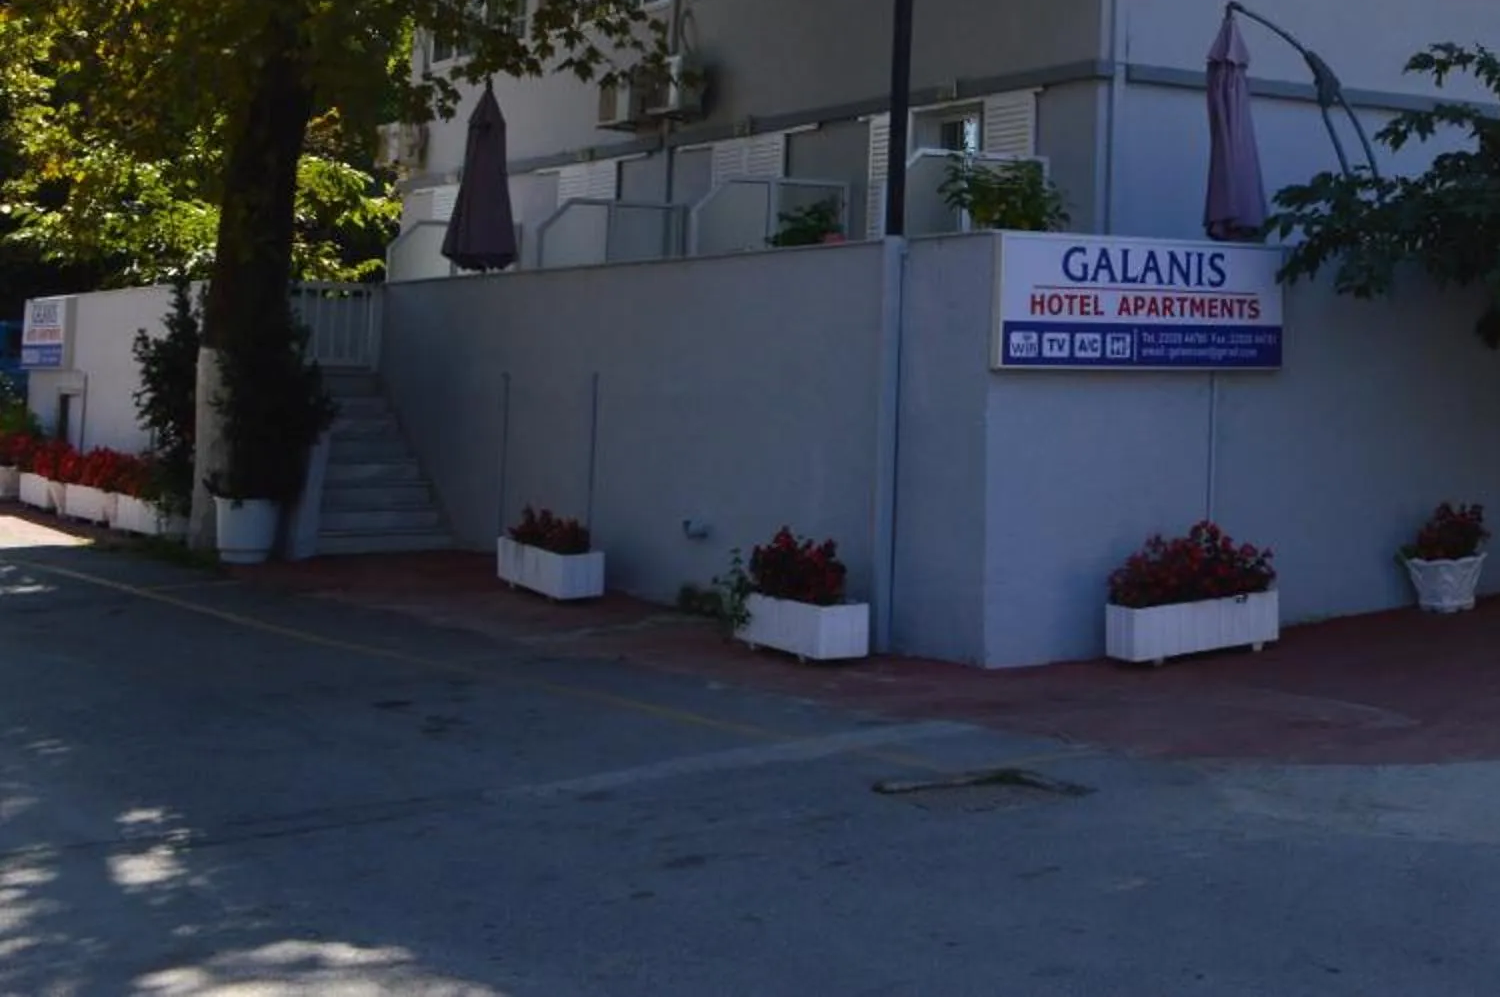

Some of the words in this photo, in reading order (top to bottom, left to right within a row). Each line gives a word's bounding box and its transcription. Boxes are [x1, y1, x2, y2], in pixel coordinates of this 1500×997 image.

[1062, 246, 1226, 288] GALANIS
[1030, 294, 1104, 317] HOTEL
[1117, 295, 1260, 319] APARTMENTS
[1047, 338, 1066, 353] TV
